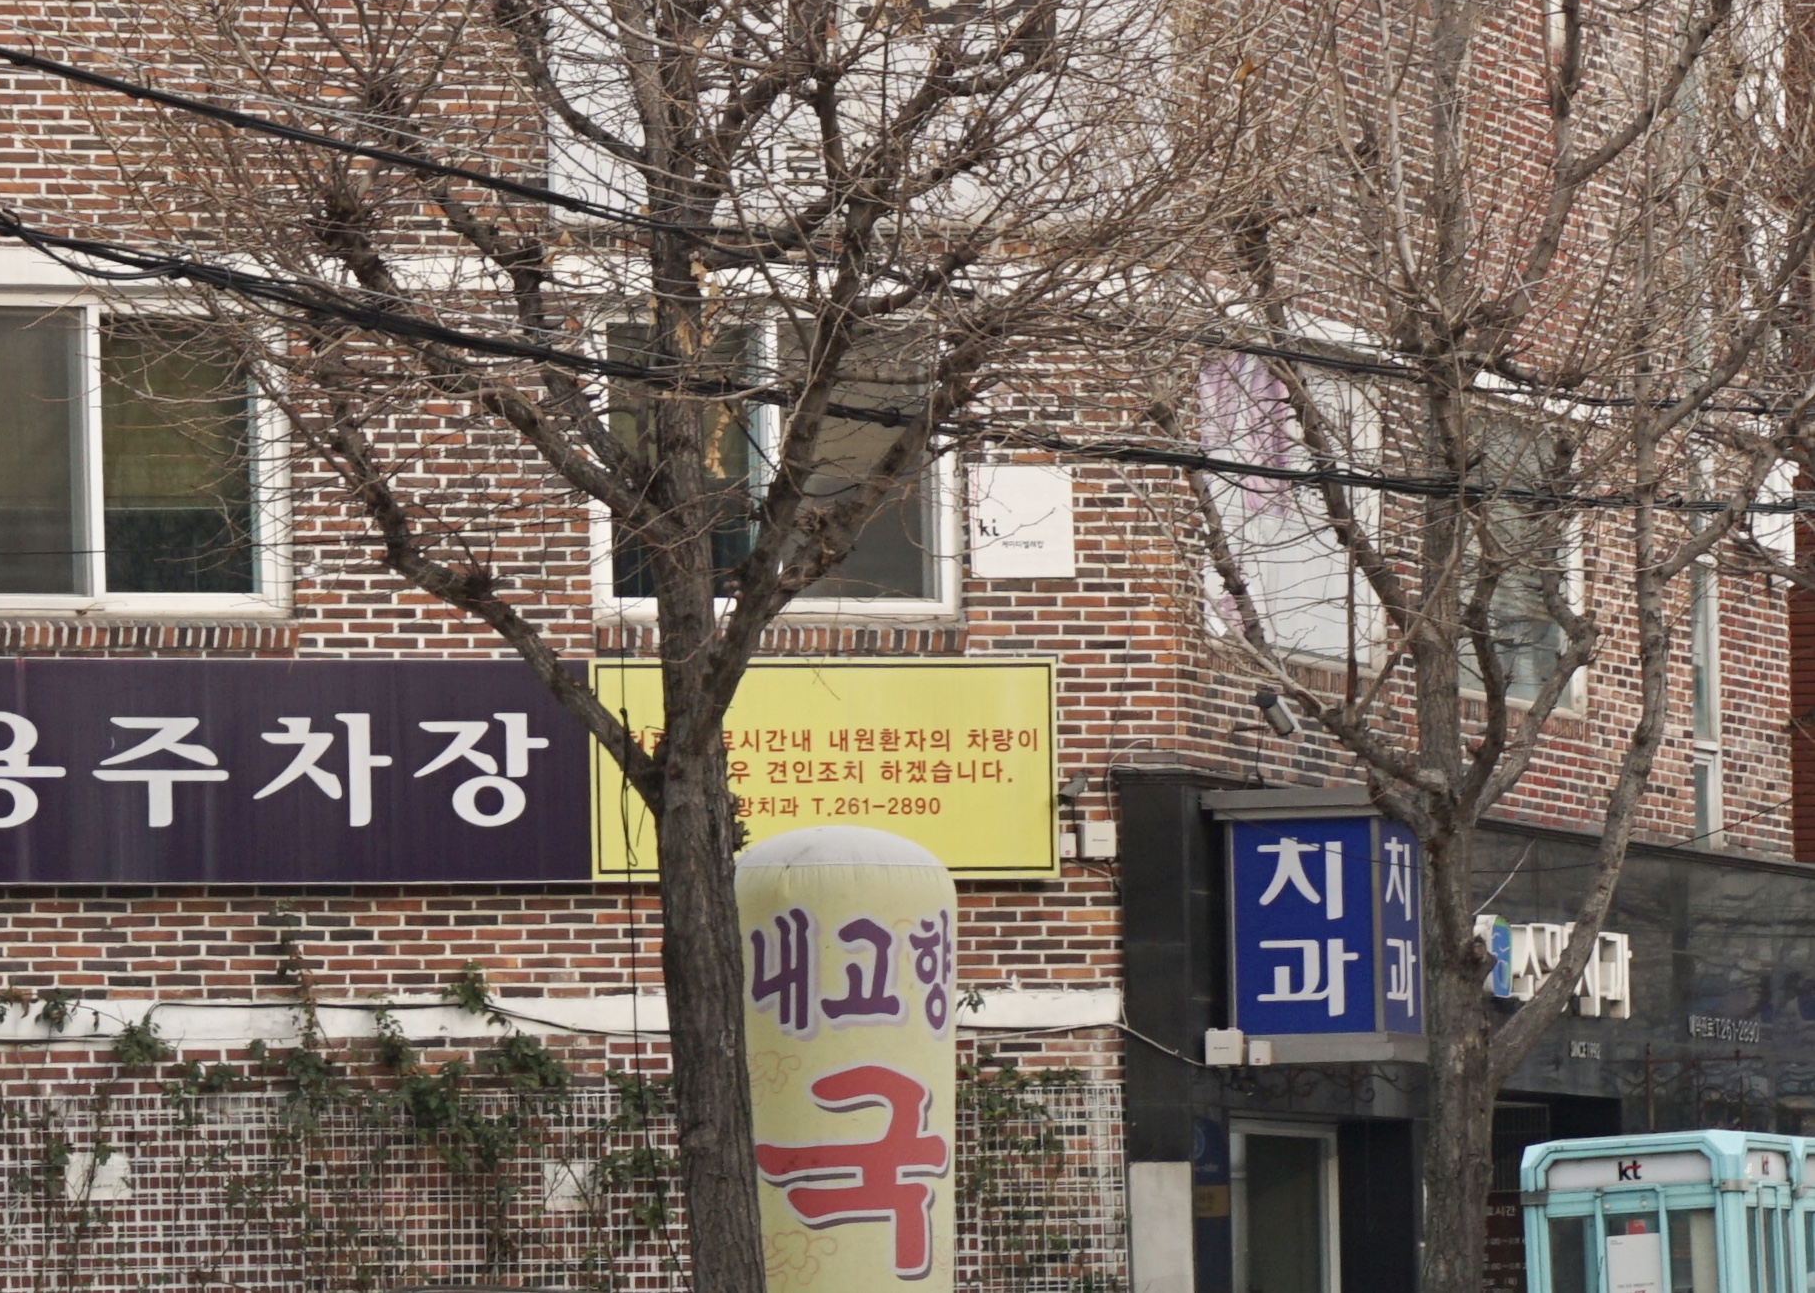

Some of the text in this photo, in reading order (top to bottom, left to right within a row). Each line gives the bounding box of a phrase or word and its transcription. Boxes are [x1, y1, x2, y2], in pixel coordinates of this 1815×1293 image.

[766, 760, 865, 784] 견인조치
[880, 760, 1014, 784] 하겠습니다.
[829, 728, 951, 753] 내원환자의
[966, 727, 1039, 753] 차량이
[737, 796, 799, 817] 망치과
[1256, 837, 1359, 1018] 치과
[1384, 836, 1417, 1018] 치과
[750, 908, 952, 1031] 내고향
[754, 1063, 948, 1271] 국
[1617, 1160, 1642, 1182] kt
